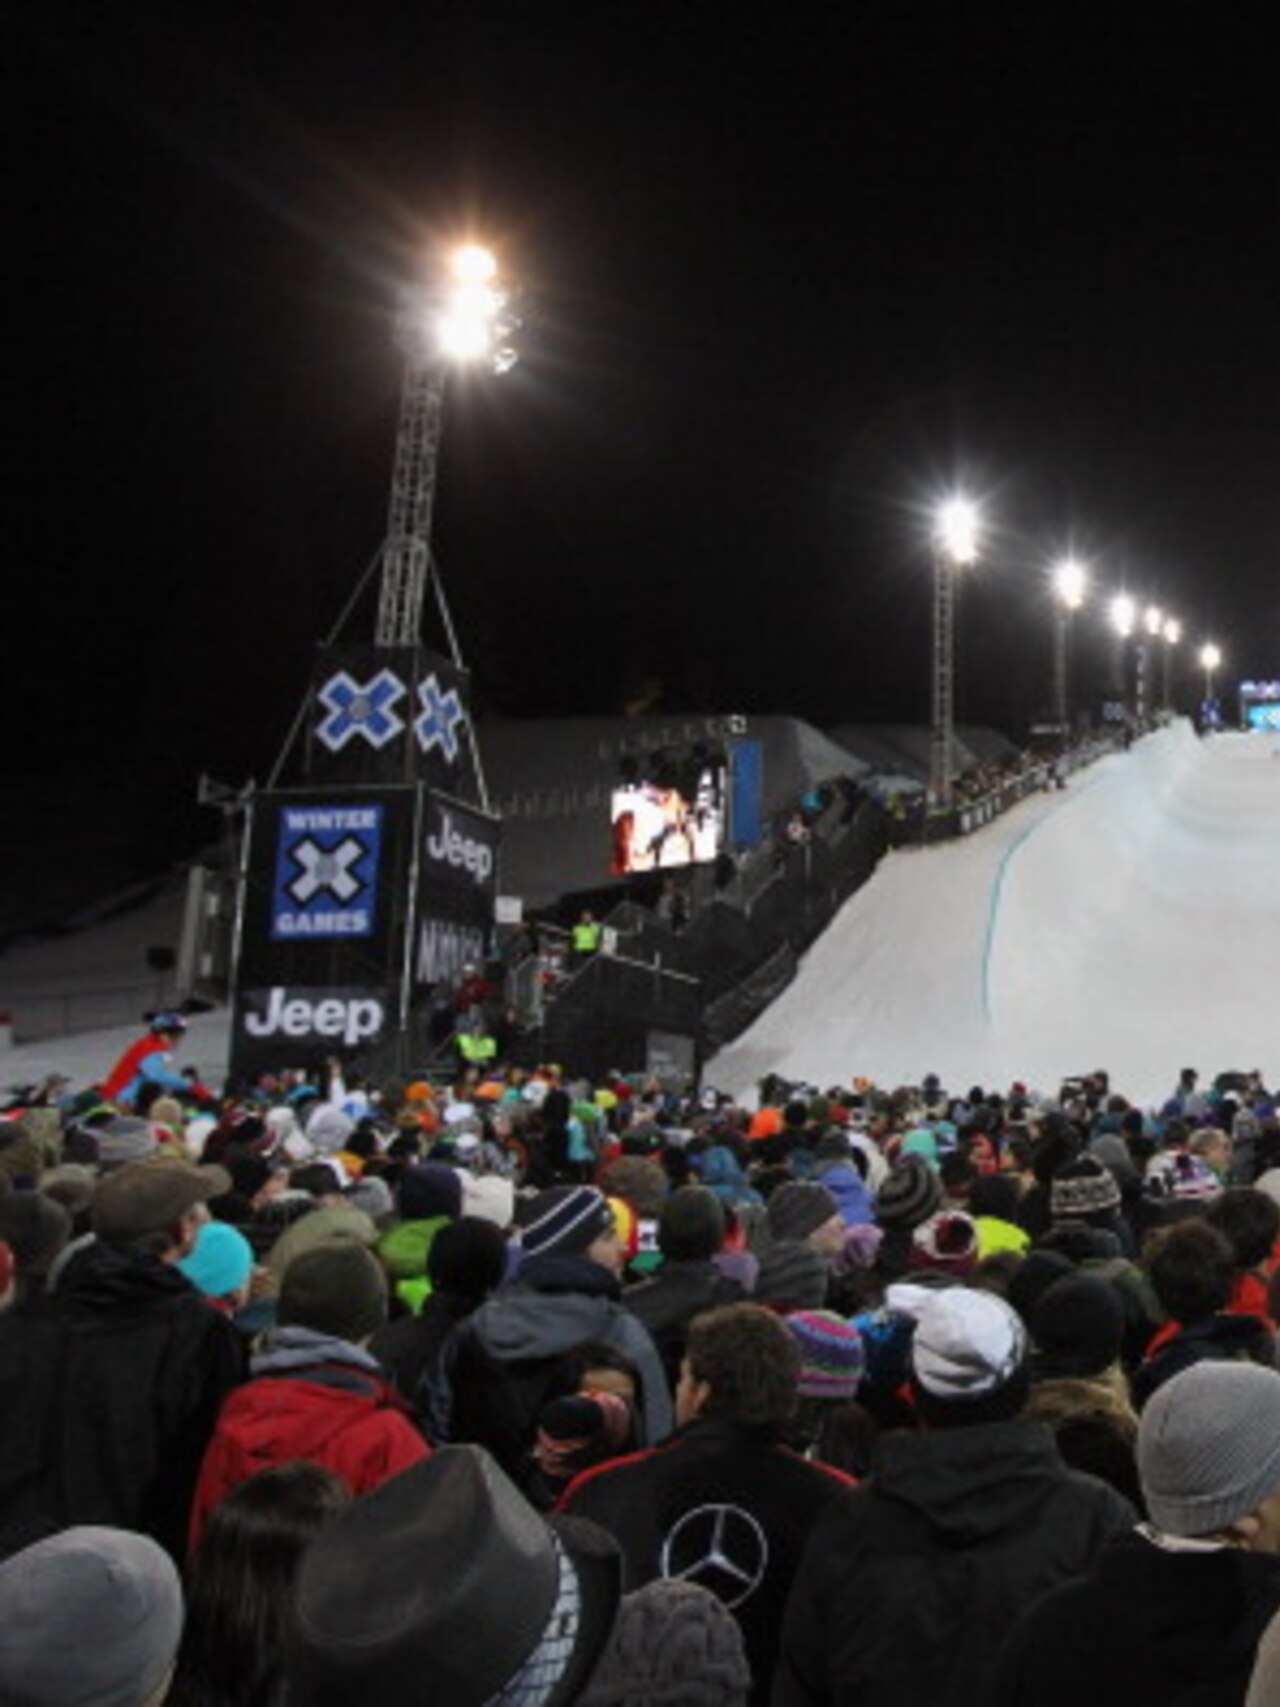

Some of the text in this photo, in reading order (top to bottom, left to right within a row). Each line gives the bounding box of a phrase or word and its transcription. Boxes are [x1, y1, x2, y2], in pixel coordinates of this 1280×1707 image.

[287, 810, 376, 828] WINTER
[428, 816, 492, 881] Jeep
[277, 911, 367, 932] GAMES
[246, 988, 382, 1044] Jeep
